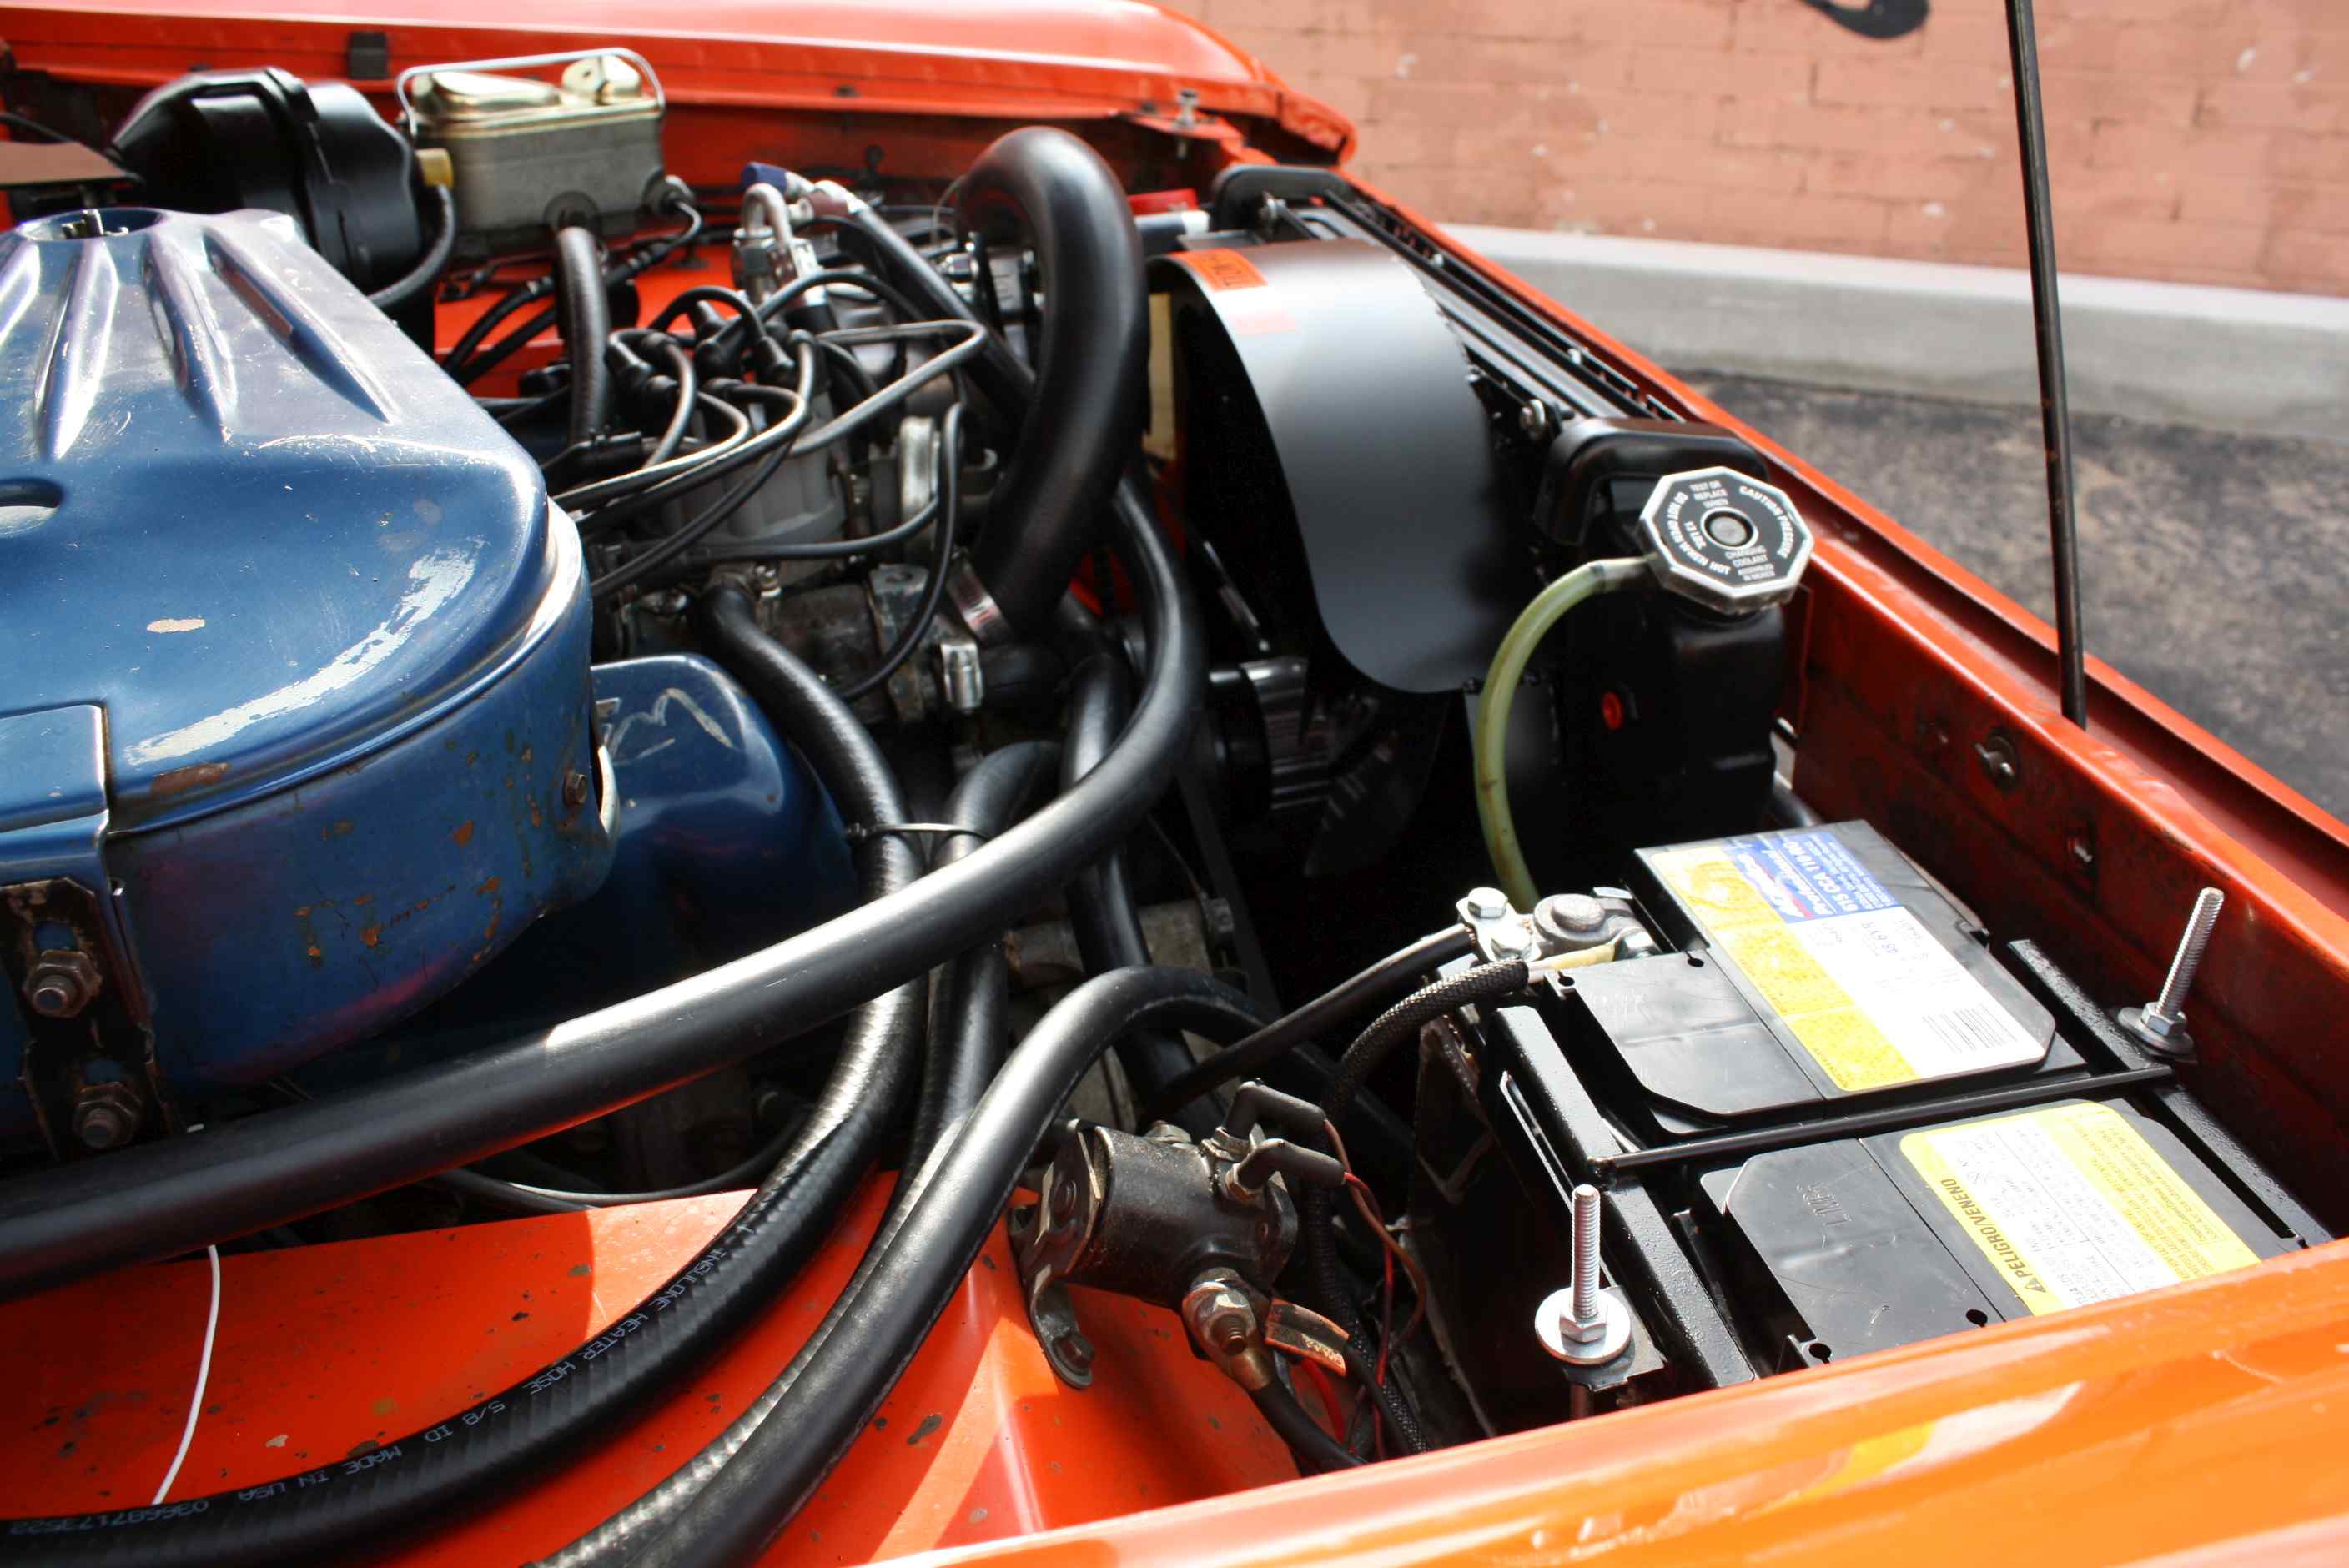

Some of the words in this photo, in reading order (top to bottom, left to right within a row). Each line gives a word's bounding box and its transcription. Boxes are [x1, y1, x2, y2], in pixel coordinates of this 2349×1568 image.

[1689, 483, 1708, 491] TEST
[1708, 480, 1722, 489] OR
[1693, 490, 1728, 501] REPLACE
[1672, 492, 1688, 505] DO
[1667, 503, 1681, 520] NOT
[1738, 485, 1783, 517] CAUTION
[1777, 515, 1794, 559] PRESSURE
[1667, 520, 1683, 543] OPEN
[1679, 540, 1710, 567] WHEN
[1725, 545, 1767, 559] CHANGING
[1732, 555, 1768, 567] COOLANT
[1709, 561, 1732, 575] HOT
[1796, 854, 1821, 871] 110
[1762, 849, 1833, 914] Professional
[1813, 872, 1843, 893] CCA
[1837, 893, 1859, 912] 615
[1940, 1178, 2032, 1277] PELIGRO/VENENO
[653, 1248, 727, 1309] INSULONE
[581, 1311, 648, 1359] HEATER
[523, 1363, 576, 1394] HOSE
[462, 1400, 505, 1425] 5/8
[423, 1424, 453, 1443] ID
[344, 1445, 402, 1475] MADE
[298, 1470, 330, 1488] IN
[238, 1481, 285, 1502] USA
